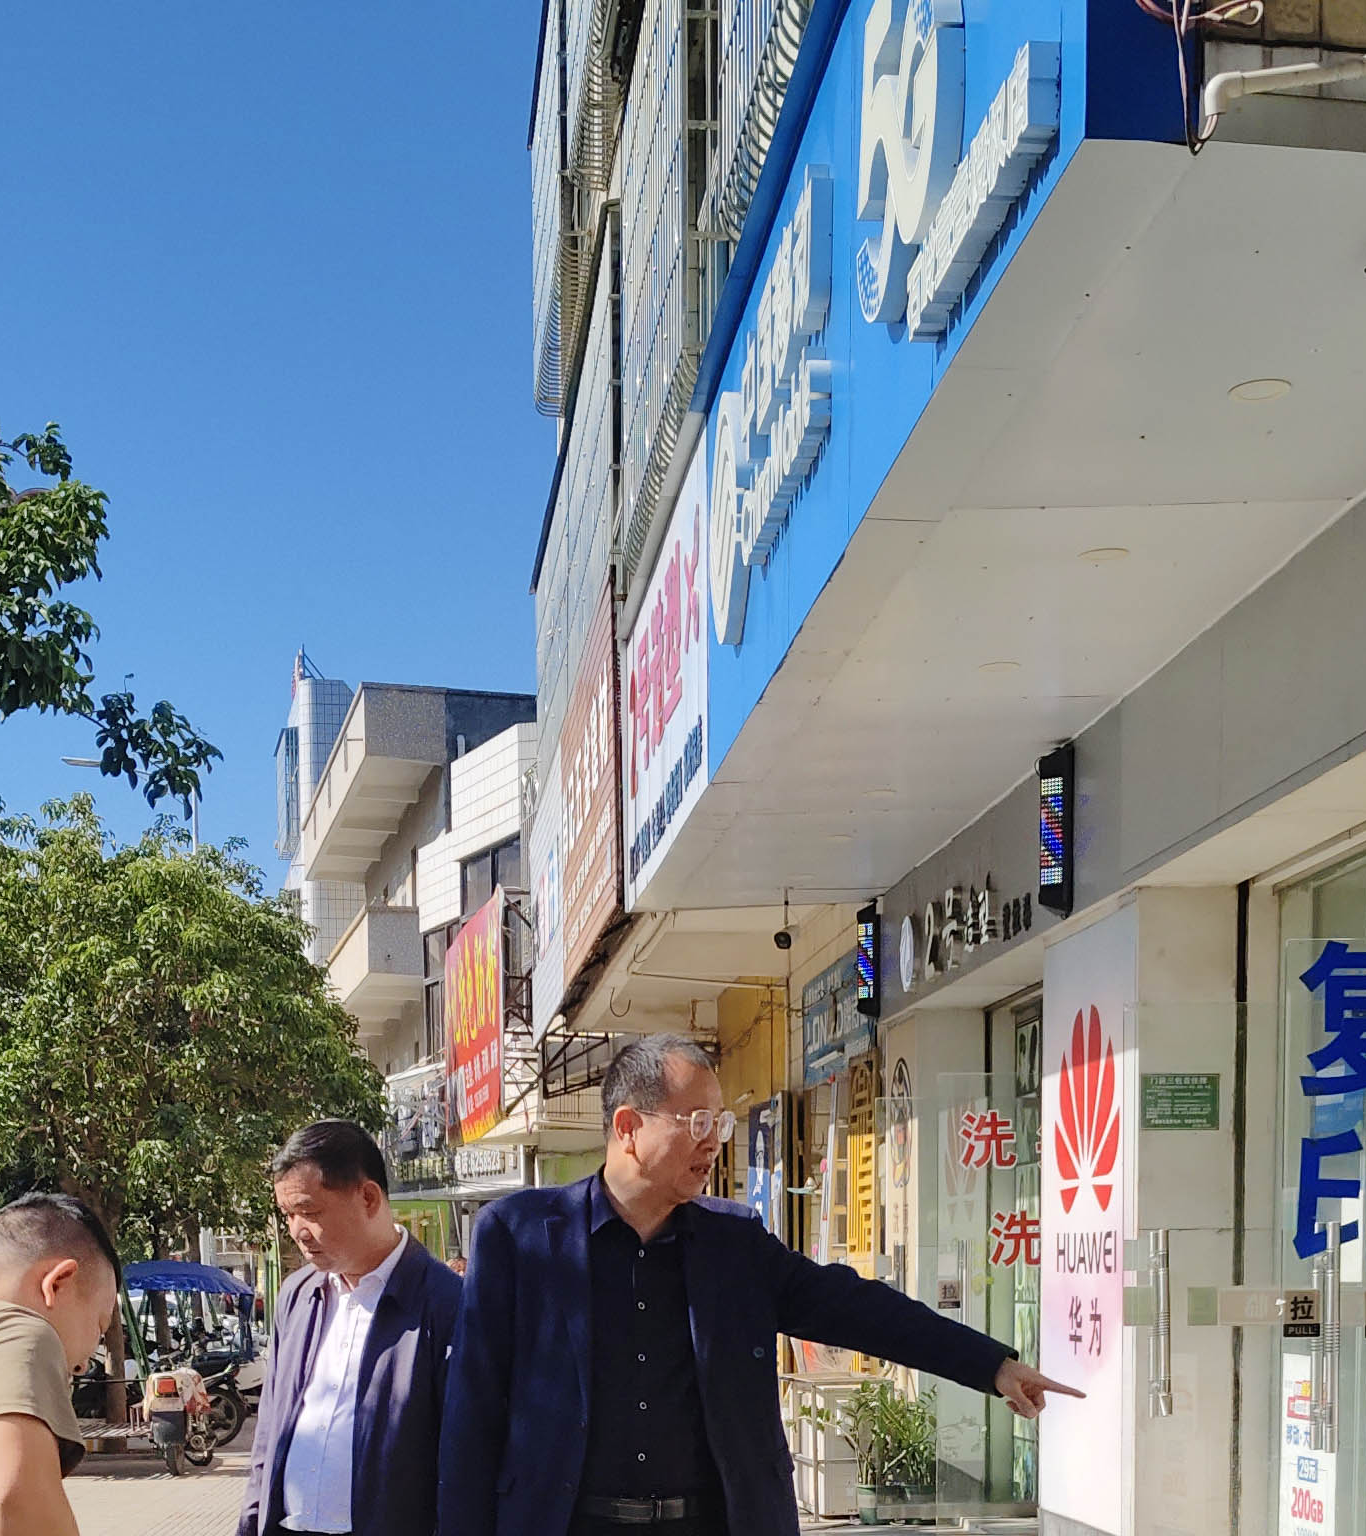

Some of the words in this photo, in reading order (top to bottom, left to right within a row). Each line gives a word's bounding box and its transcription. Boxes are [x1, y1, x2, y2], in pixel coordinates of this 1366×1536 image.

[959, 1110, 1017, 1170] 洗
[1056, 1230, 1118, 1274] HUAWEI
[1069, 1295, 1103, 1357] 华为
[1290, 1296, 1315, 1321] 拉
[1291, 1486, 1324, 1524] 200GB
